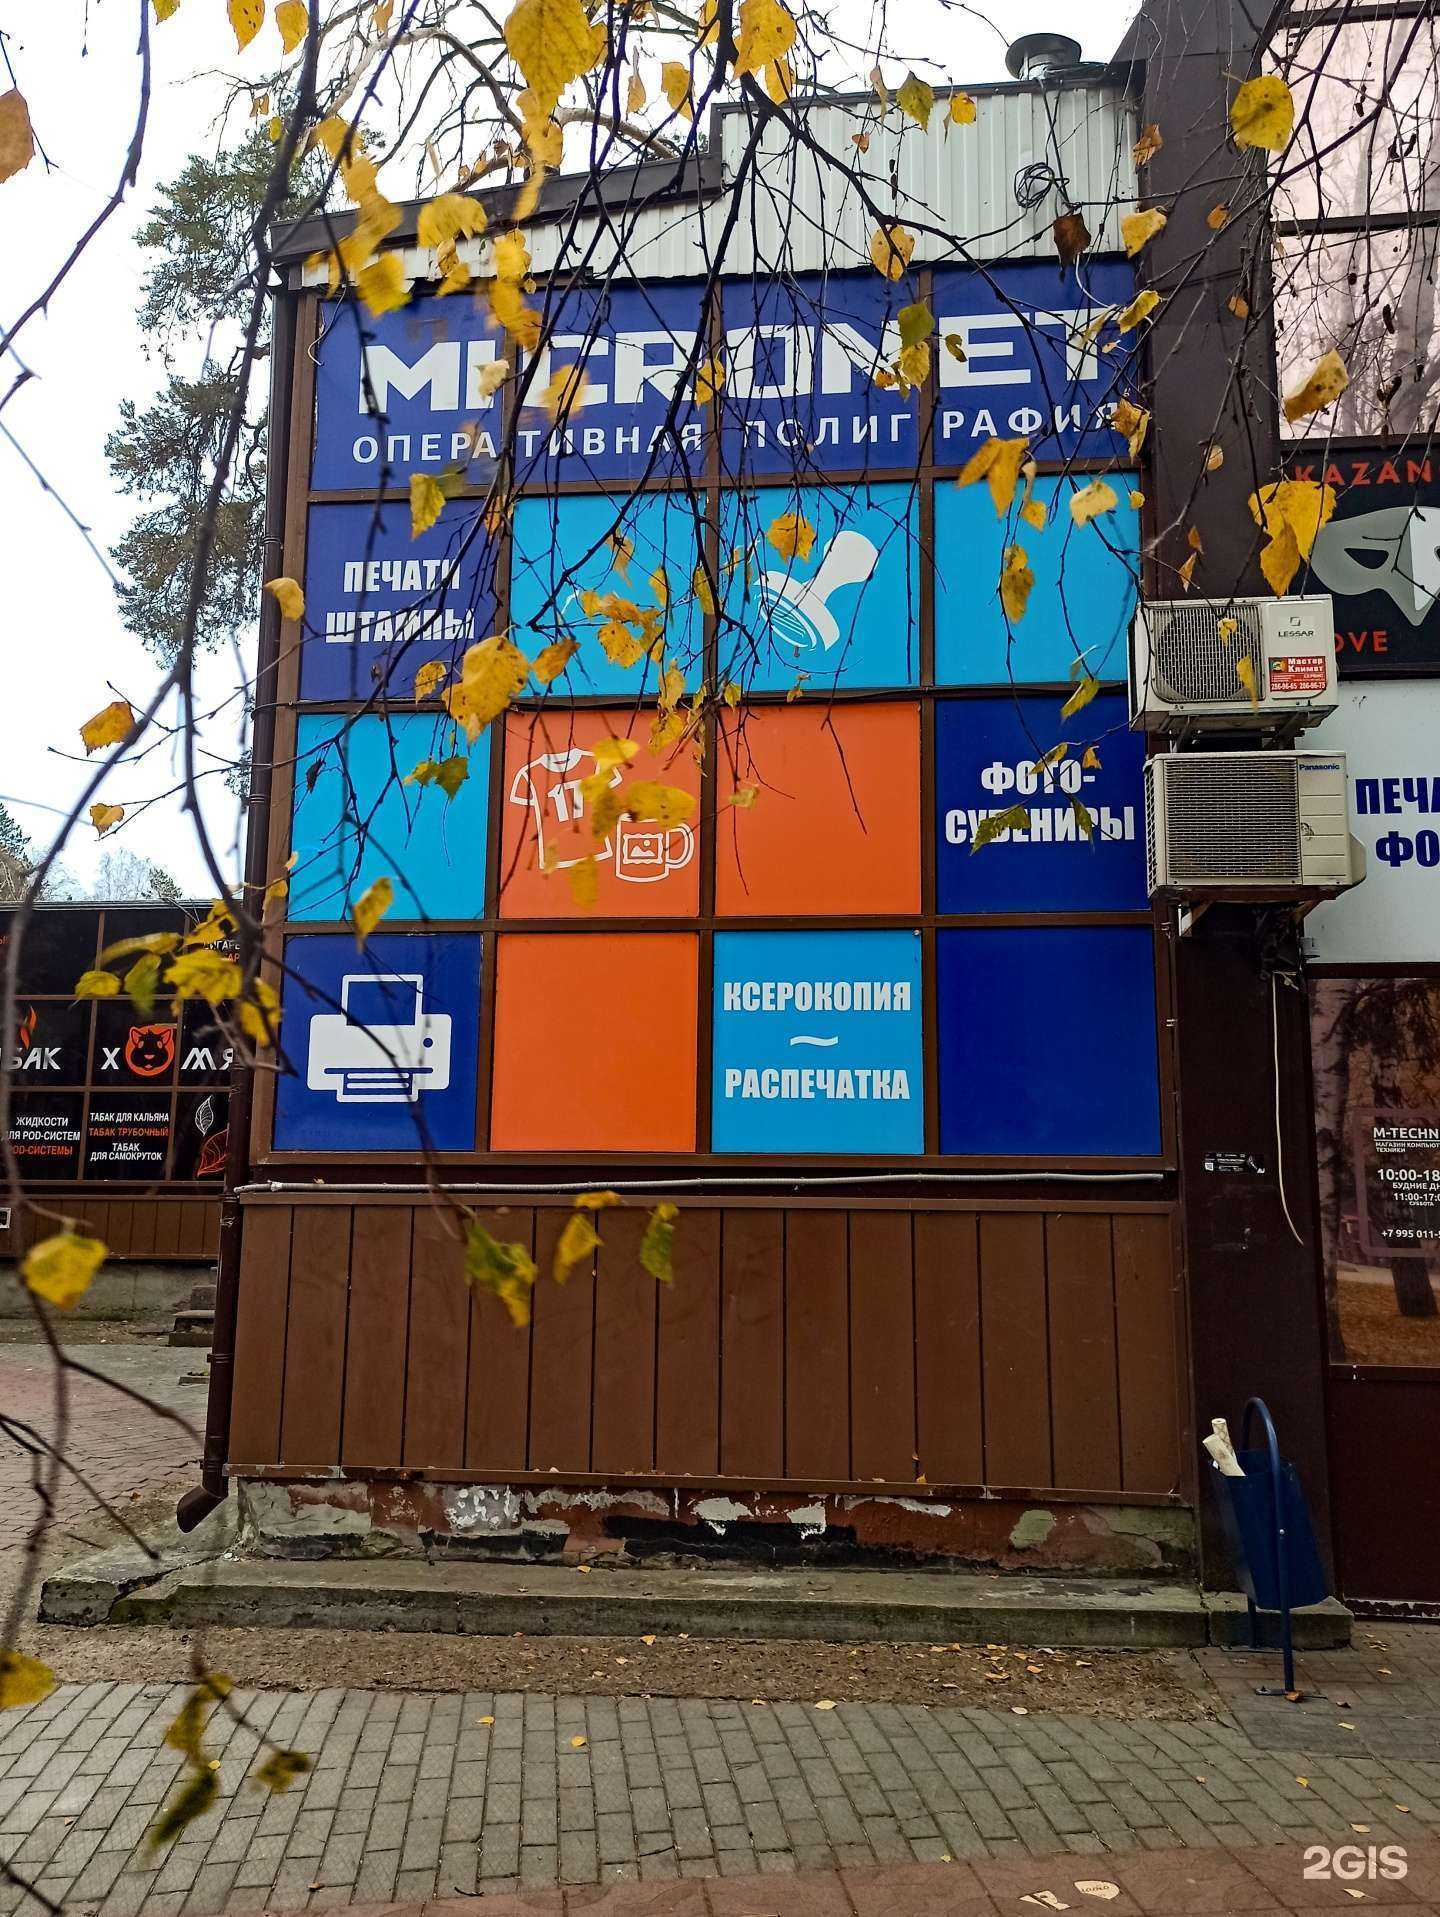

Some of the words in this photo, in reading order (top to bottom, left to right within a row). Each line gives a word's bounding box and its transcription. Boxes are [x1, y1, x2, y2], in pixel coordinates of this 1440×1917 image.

[358, 307, 1123, 414] MICRONET
[1294, 459, 1440, 485] KAZAN
[343, 558, 461, 593] ПЕЧАТИ
[325, 607, 476, 643] ШТАМПЫ
[1278, 630, 1314, 638] LESSAR
[1288, 665, 1323, 673] Климат
[1299, 763, 1340, 771] Panasonic
[981, 760, 1096, 796] ФОТО-
[1375, 829, 1440, 868] ФО
[723, 981, 911, 1012] КСЕРОКОПИЯ
[0, 1047, 62, 1070] БАК
[725, 1068, 911, 1100] РАСПЕЧАТКА
[15, 1116, 69, 1127] ЖИДКОСТИ
[90, 1112, 114, 1122] ТАБАК
[116, 1113, 132, 1123] ДЛЯ
[133, 1112, 169, 1122] КАЛЬЯНА
[7, 1131, 21, 1141] ЛЯ
[89, 1127, 116, 1136] ТАБАК
[118, 1126, 169, 1136] ТРУБОЧНЫЙ
[1373, 1127, 1439, 1139] M-TECHN
[10, 1145, 73, 1155] OD-СИСТЕМЫ
[112, 1142, 140, 1152] ТАБАК
[90, 1151, 108, 1162] ДЛЯ
[108, 1150, 163, 1161] САМОКРУТОК
[1382, 1229, 1393, 1237] +7
[1395, 1229, 1414, 1238] 995
